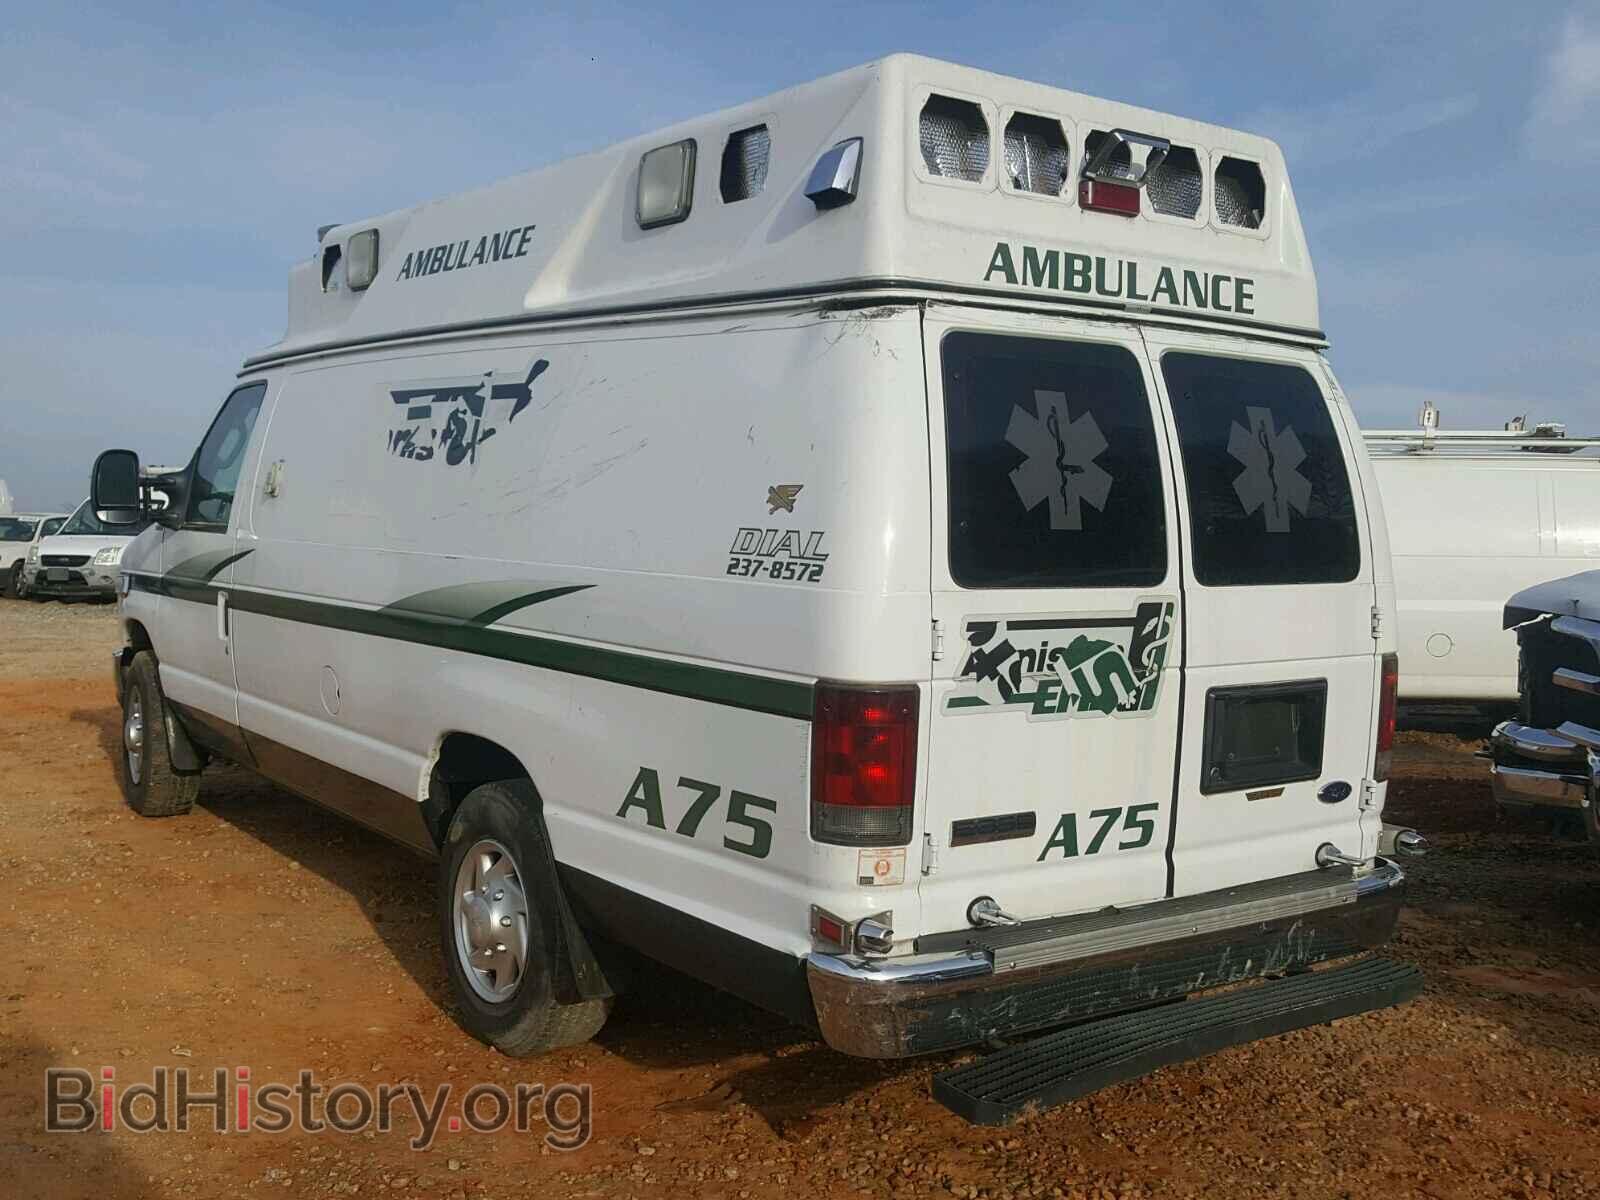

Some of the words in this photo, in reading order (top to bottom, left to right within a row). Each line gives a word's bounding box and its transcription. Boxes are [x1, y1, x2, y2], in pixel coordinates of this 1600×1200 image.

[396, 224, 536, 281] AMBULANCE
[983, 242, 1254, 314] AMBULANCE
[726, 557, 824, 582] 237-8572
[729, 527, 829, 561] DIAL
[616, 766, 777, 859] A75
[1036, 802, 1159, 862] A75
